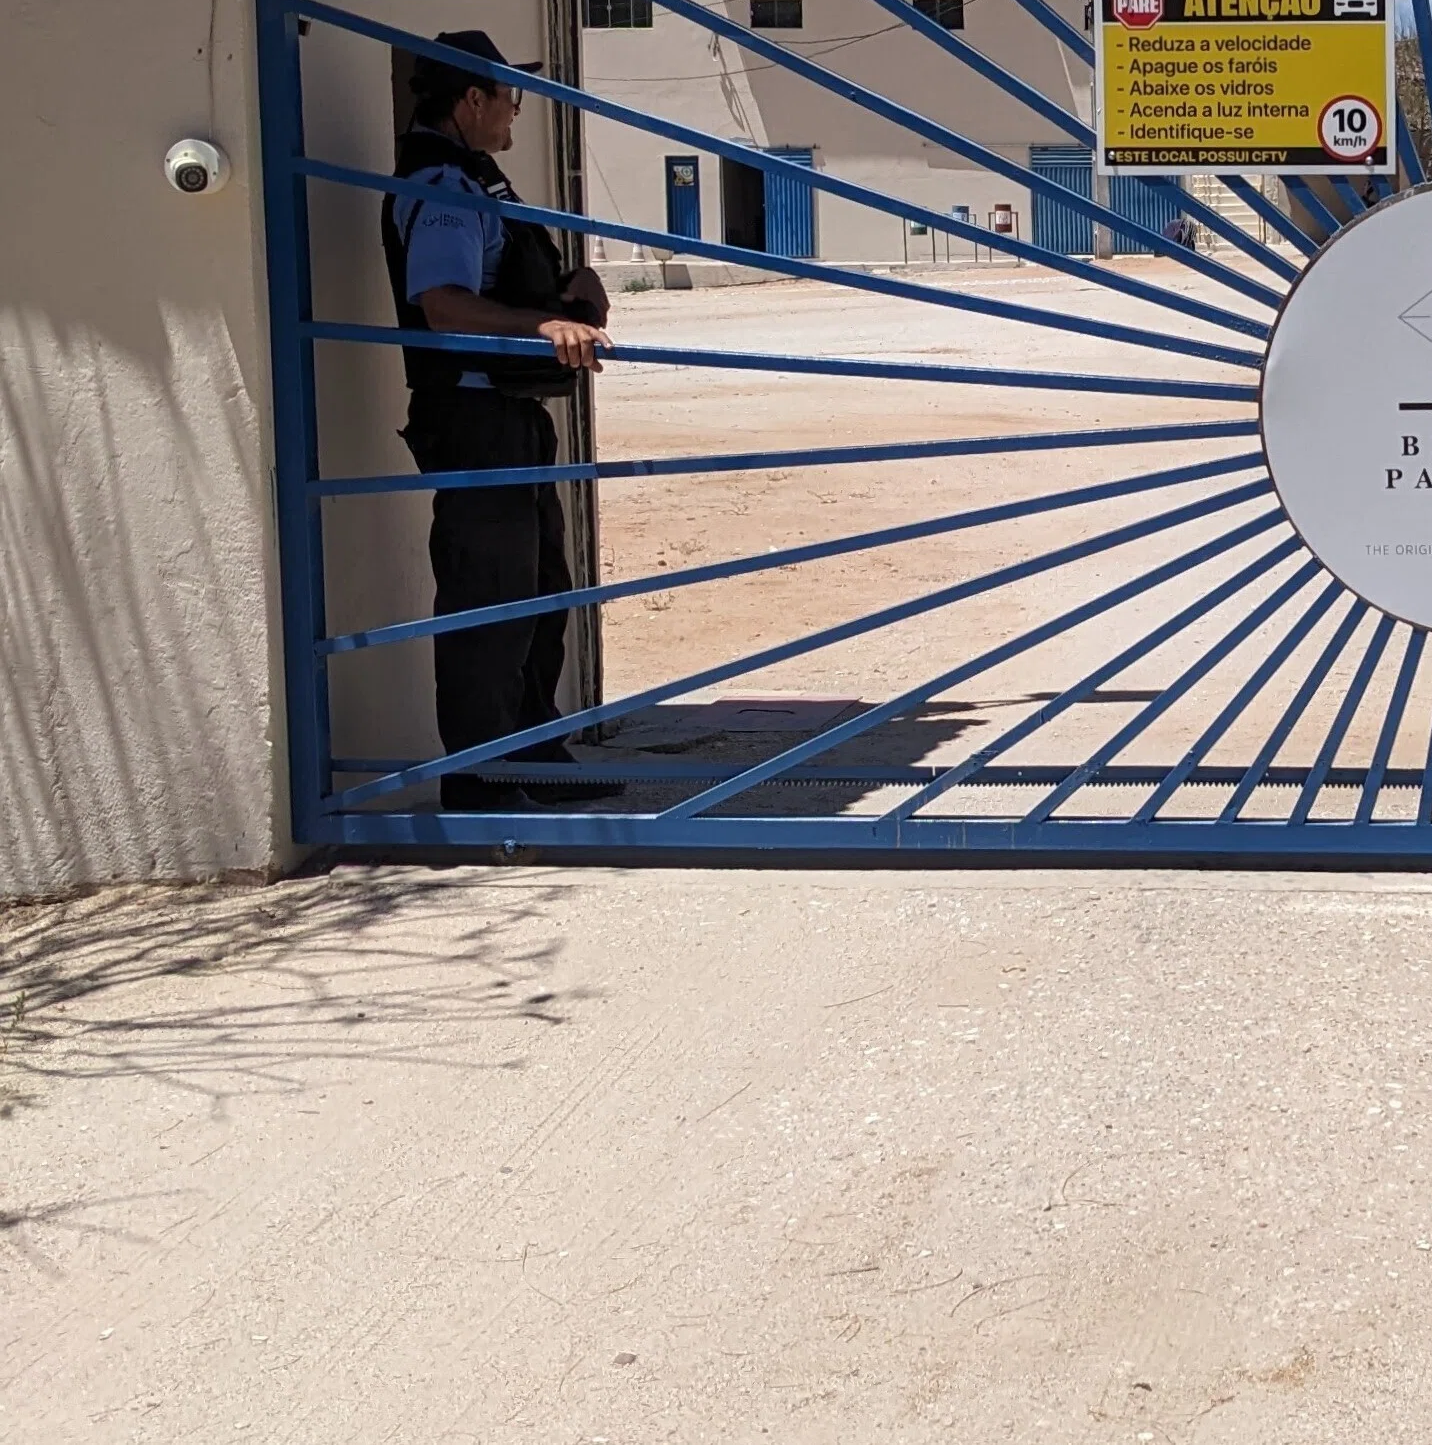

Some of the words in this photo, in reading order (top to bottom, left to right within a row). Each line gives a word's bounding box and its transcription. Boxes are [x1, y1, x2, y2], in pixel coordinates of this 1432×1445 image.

[1129, 36, 1195, 52] Reduza
[1200, 40, 1210, 52] a
[1215, 35, 1311, 51] velocidade
[1129, 59, 1198, 77] Apague
[1203, 62, 1224, 74] os
[1229, 58, 1277, 74] faróis
[1130, 80, 1190, 96] Abaixe
[1194, 84, 1215, 96] os
[1220, 80, 1274, 96] vidros
[1130, 102, 1197, 118] Acenda
[1202, 106, 1212, 117] a
[1217, 102, 1242, 117] luz
[1247, 101, 1309, 117] interna
[1332, 108, 1367, 133] 10
[1130, 123, 1254, 142] Identifique-se
[1333, 135, 1367, 149] km/h
[1116, 151, 1149, 163] ESTE
[1152, 151, 1195, 163] LOCAL
[1199, 151, 1249, 162] POSSUI
[1251, 150, 1288, 162] CFTV
[1365, 544, 1390, 556] THE
